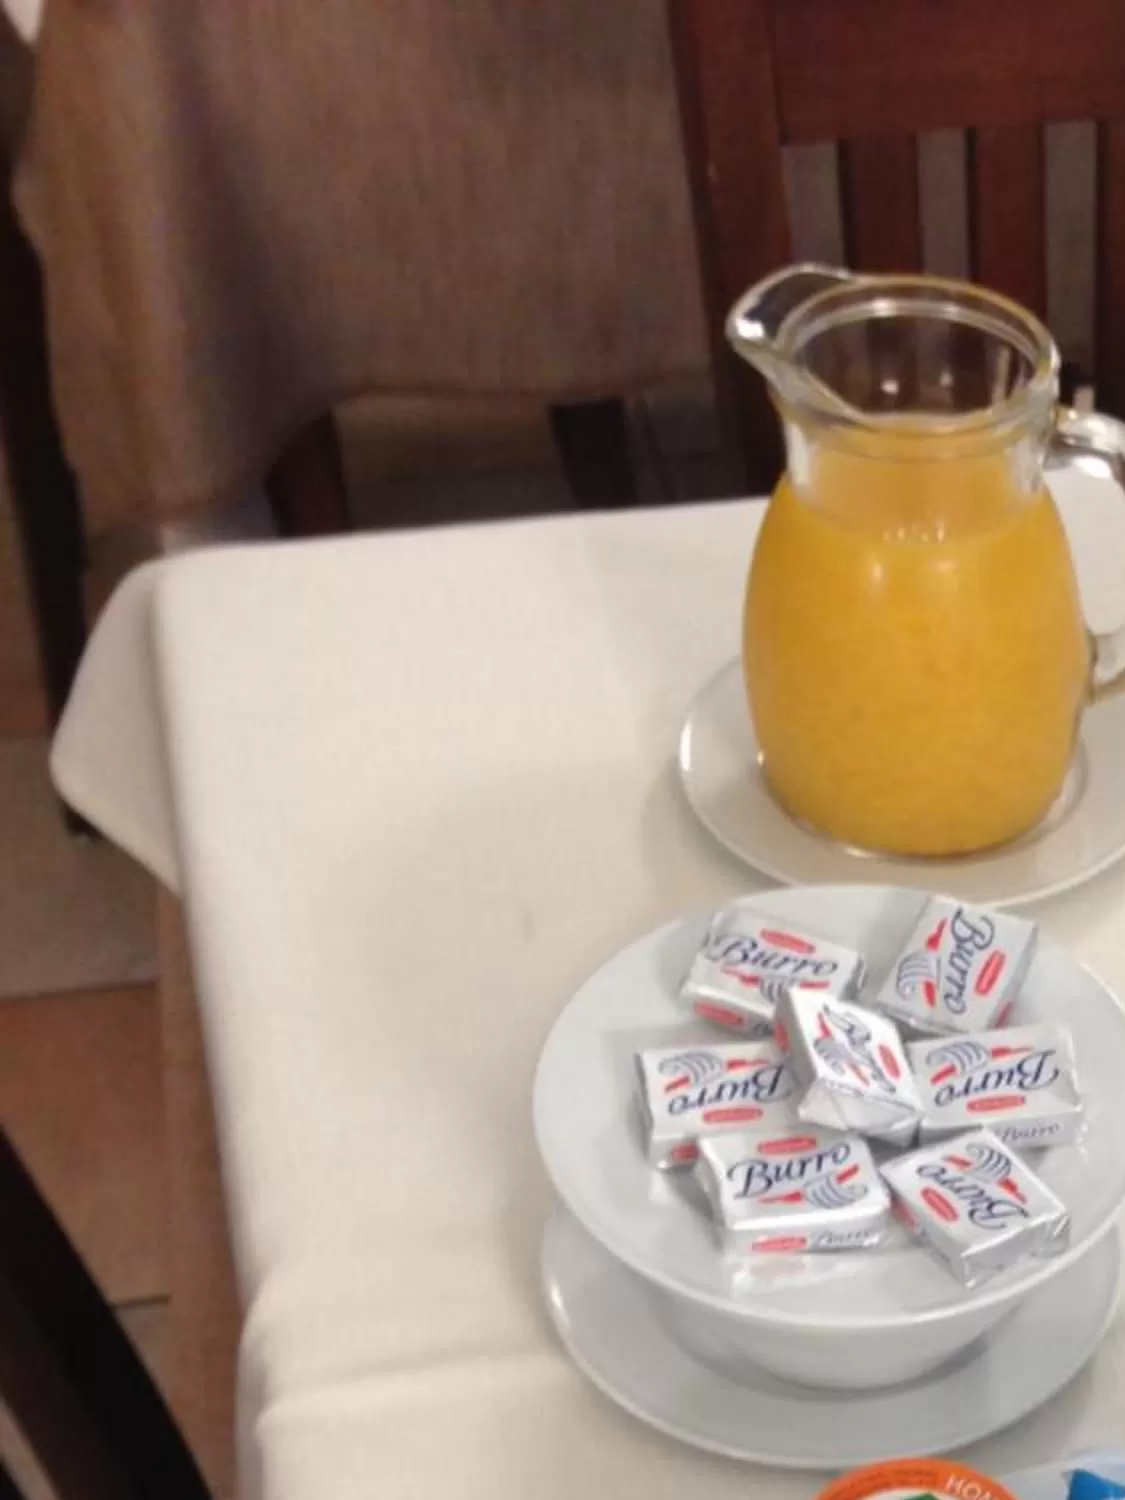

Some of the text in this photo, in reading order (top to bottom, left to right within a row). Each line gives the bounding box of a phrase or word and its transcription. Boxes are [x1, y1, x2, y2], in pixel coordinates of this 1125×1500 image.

[707, 934, 838, 976] Burro
[943, 907, 996, 1015] Burro
[666, 1061, 798, 1115] Burro
[933, 1048, 1060, 1107] Burro
[726, 1142, 852, 1199] Burro
[917, 1162, 1030, 1231] Burro
